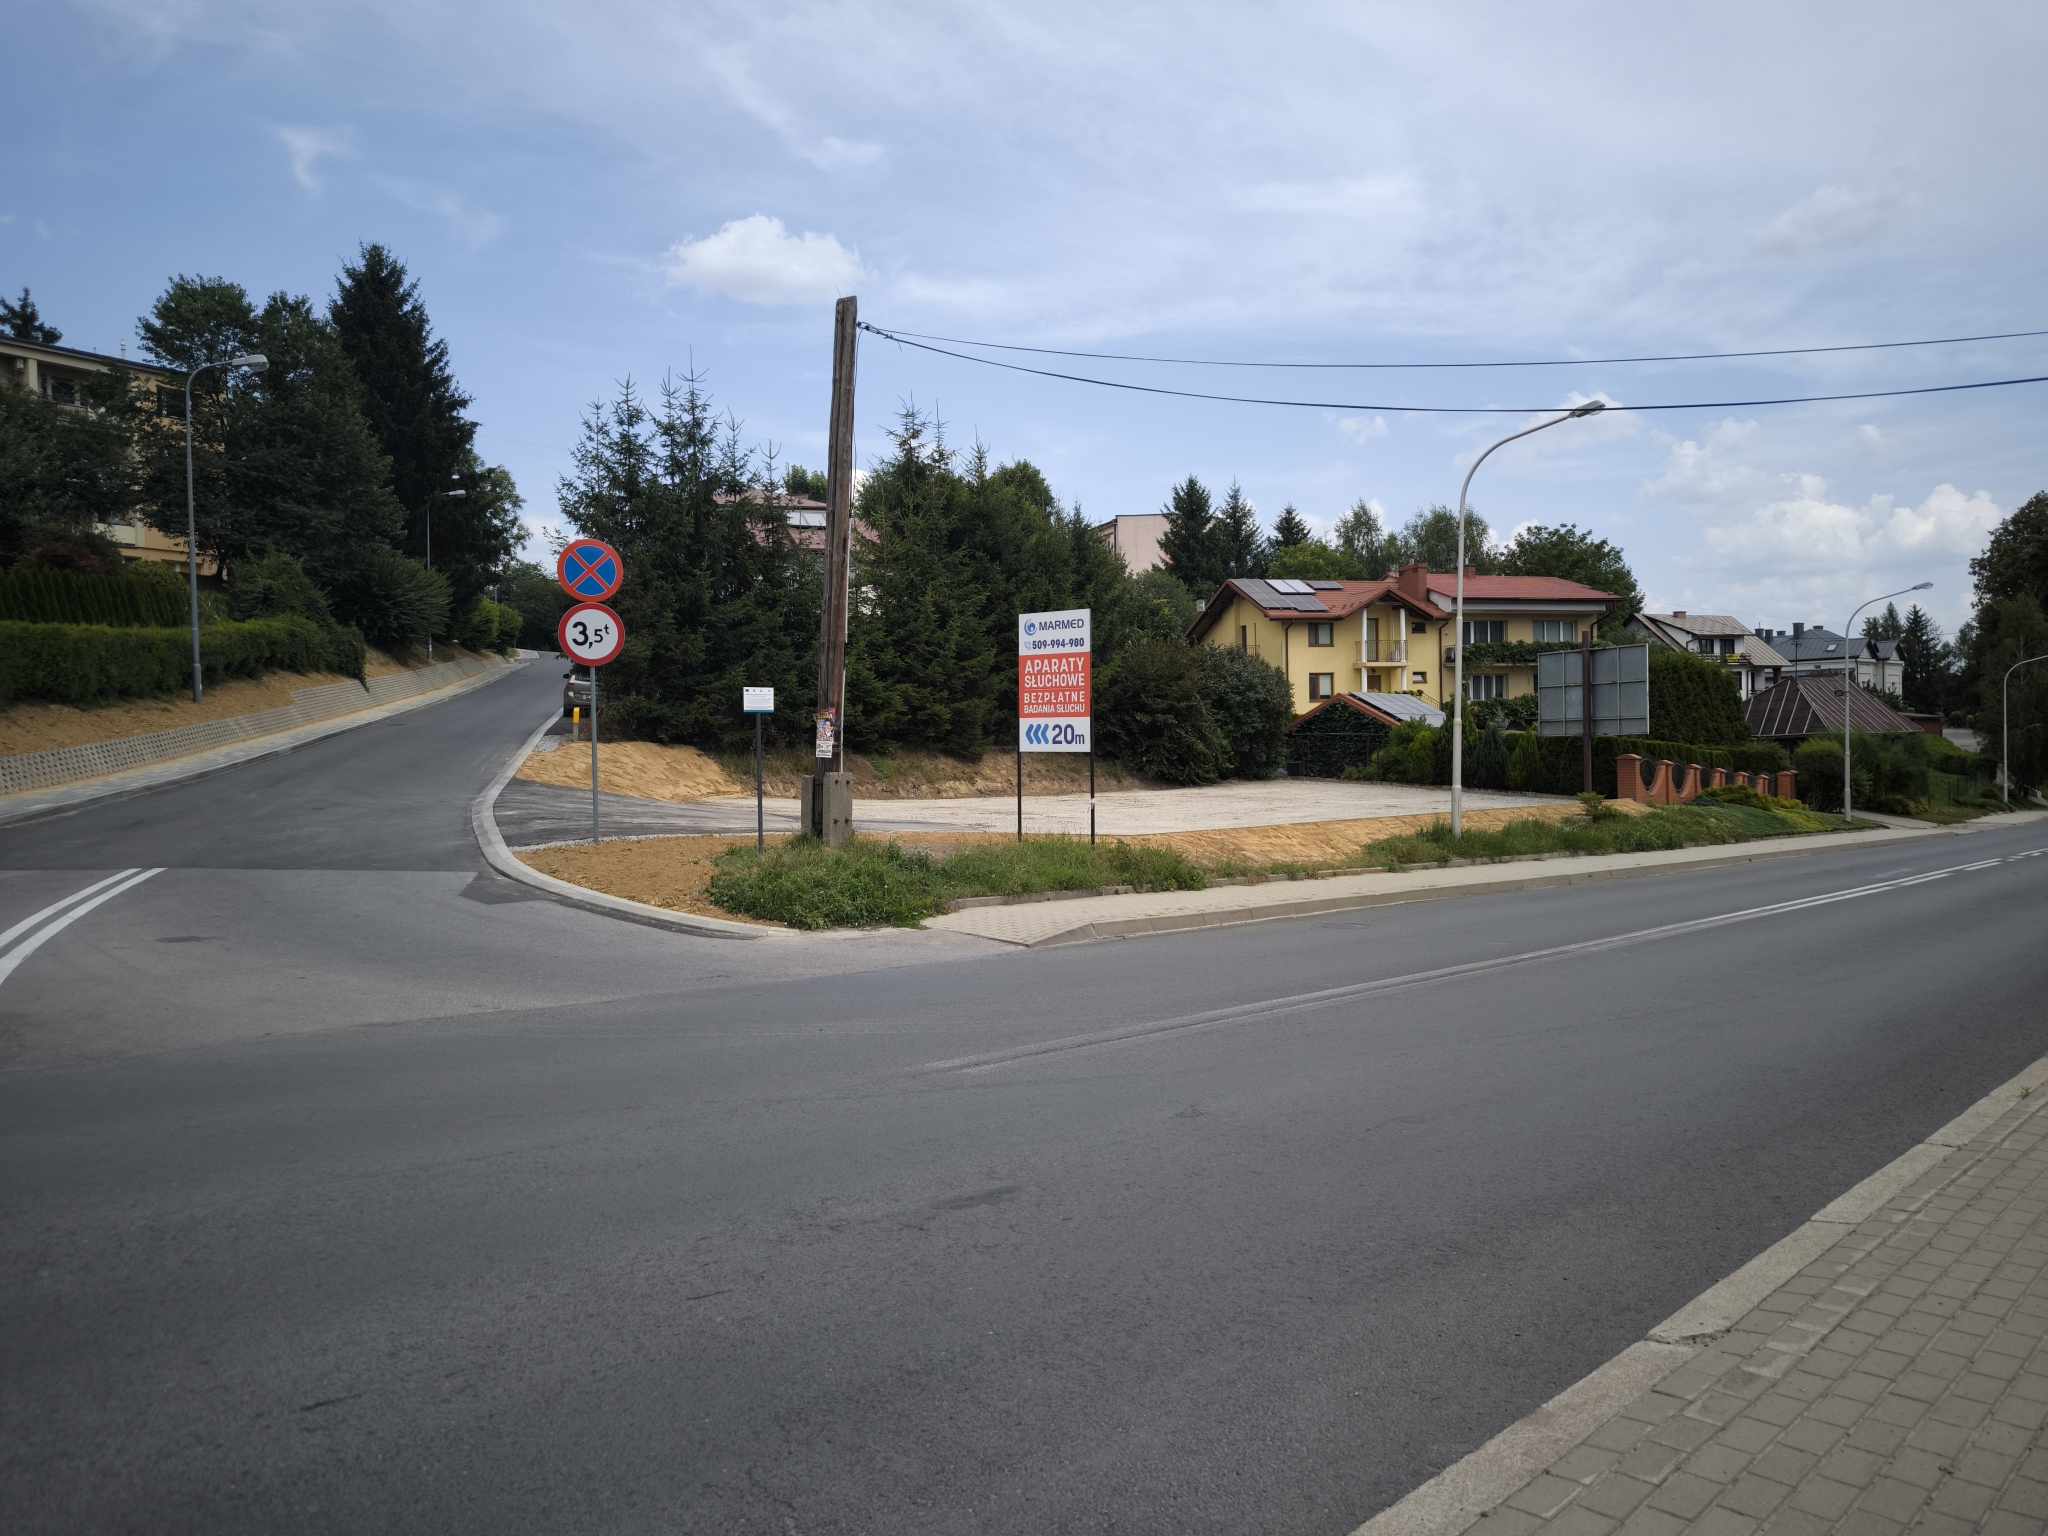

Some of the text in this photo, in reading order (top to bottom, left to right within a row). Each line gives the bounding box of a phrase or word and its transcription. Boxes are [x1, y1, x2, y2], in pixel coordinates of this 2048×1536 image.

[1039, 619, 1084, 631] MARMED
[1032, 638, 1085, 650] 509-994-980
[1025, 657, 1085, 674] APARATY
[1024, 673, 1085, 688] SŁUCHOWE
[1024, 691, 1085, 704] BEZPŁATNE
[1024, 703, 1085, 714] BADANIA SŁUCHU
[1052, 724, 1085, 745] 20m
